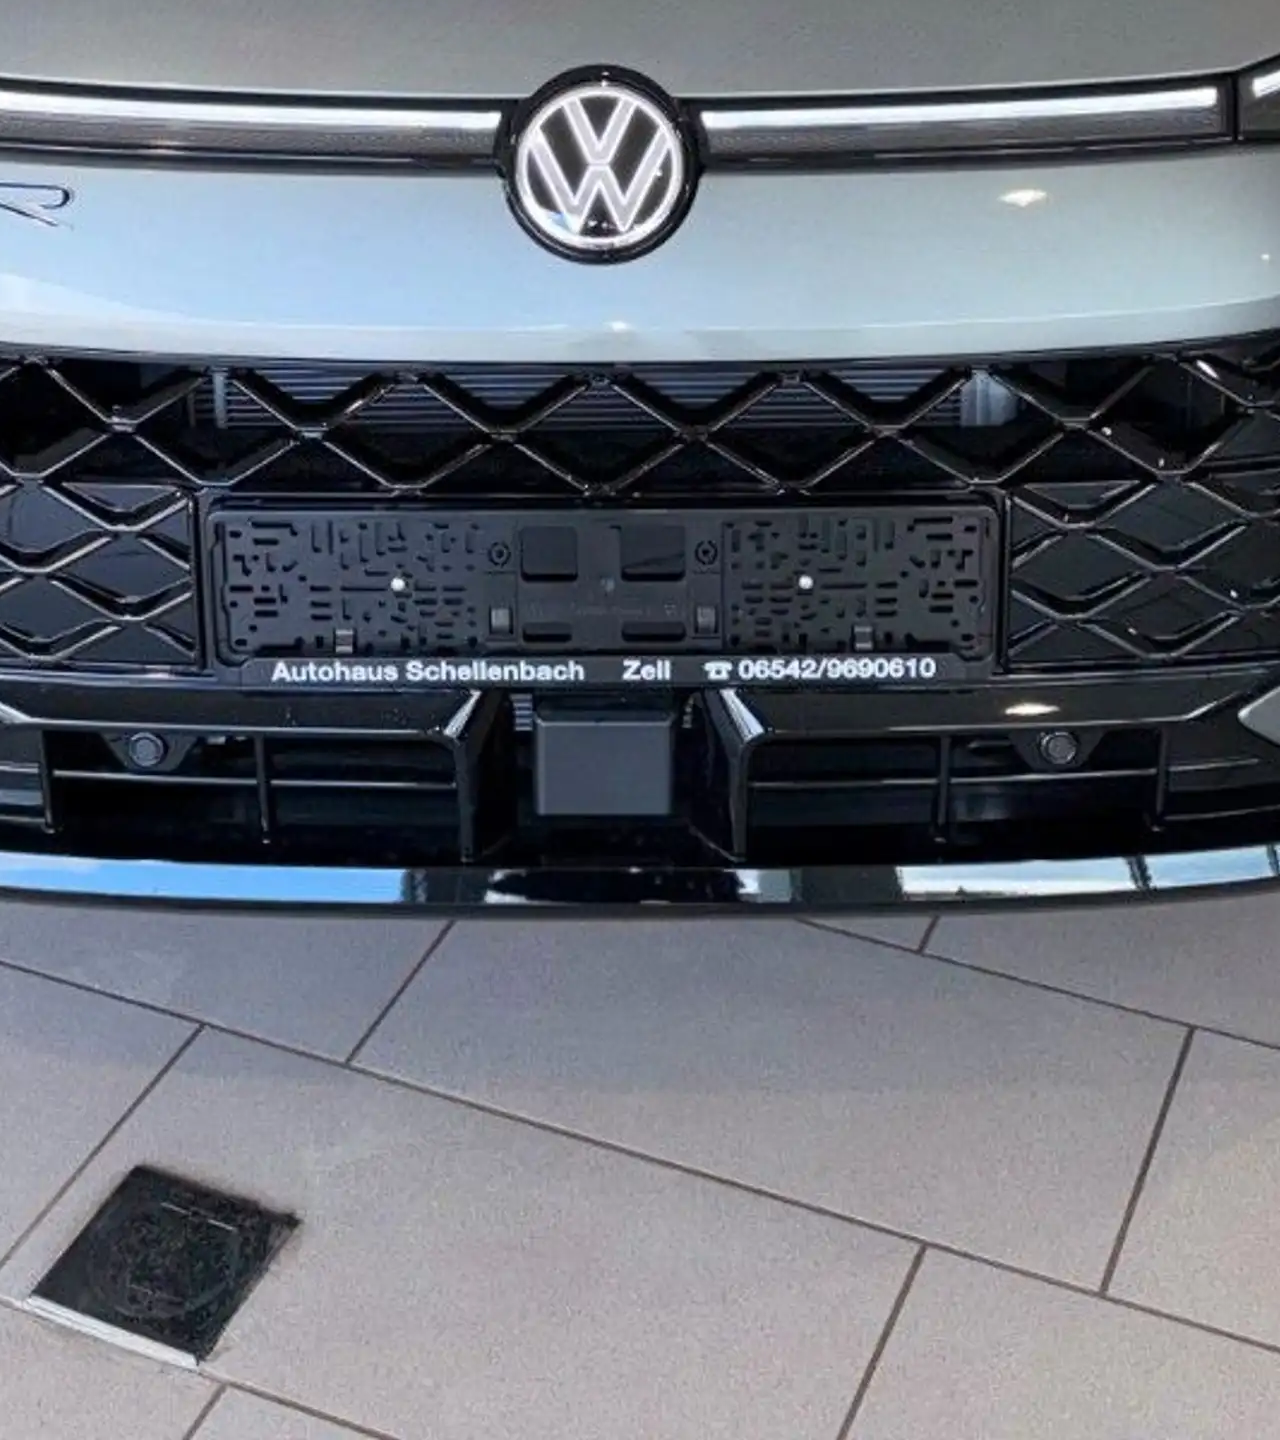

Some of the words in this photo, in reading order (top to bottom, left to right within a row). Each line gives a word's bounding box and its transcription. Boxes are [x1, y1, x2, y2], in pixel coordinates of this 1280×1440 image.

[271, 660, 399, 682] Autohaus
[405, 660, 585, 682] Schellenbach
[622, 659, 671, 681] Zell
[737, 657, 937, 680] 06542/9690610
